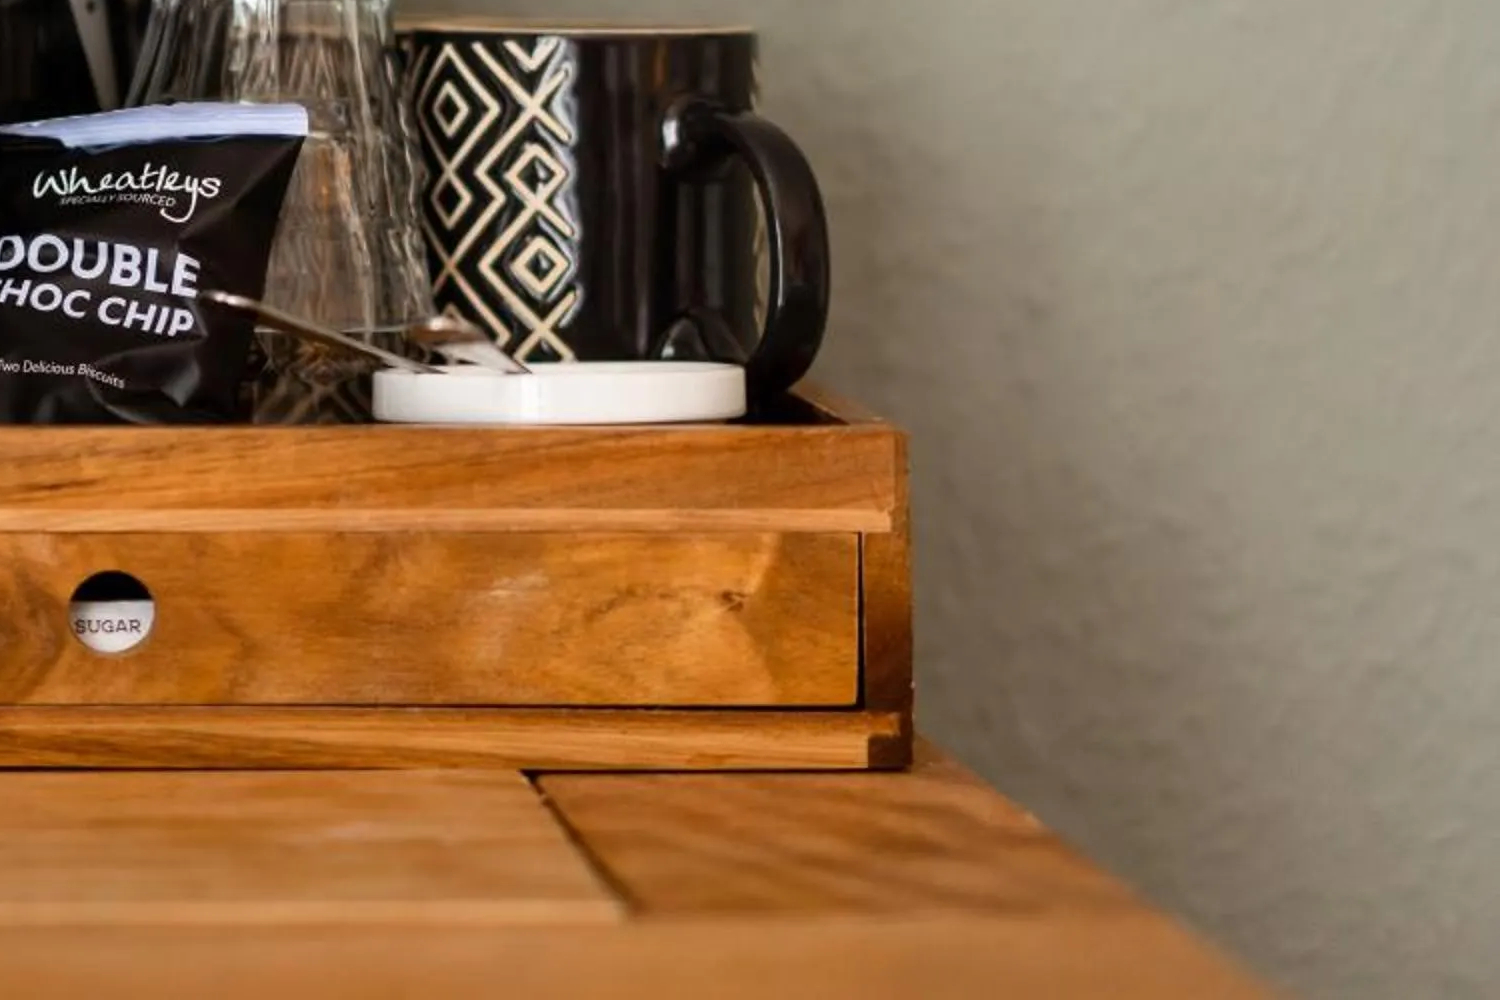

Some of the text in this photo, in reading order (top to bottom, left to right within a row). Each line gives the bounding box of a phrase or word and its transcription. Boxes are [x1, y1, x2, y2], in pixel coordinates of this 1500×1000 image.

[117, 192, 177, 207] SOURCED
[97, 296, 195, 337] CHIP
[23, 359, 75, 375] Delicious
[78, 362, 125, 389] Biscuits
[74, 619, 141, 634] SUGAR
